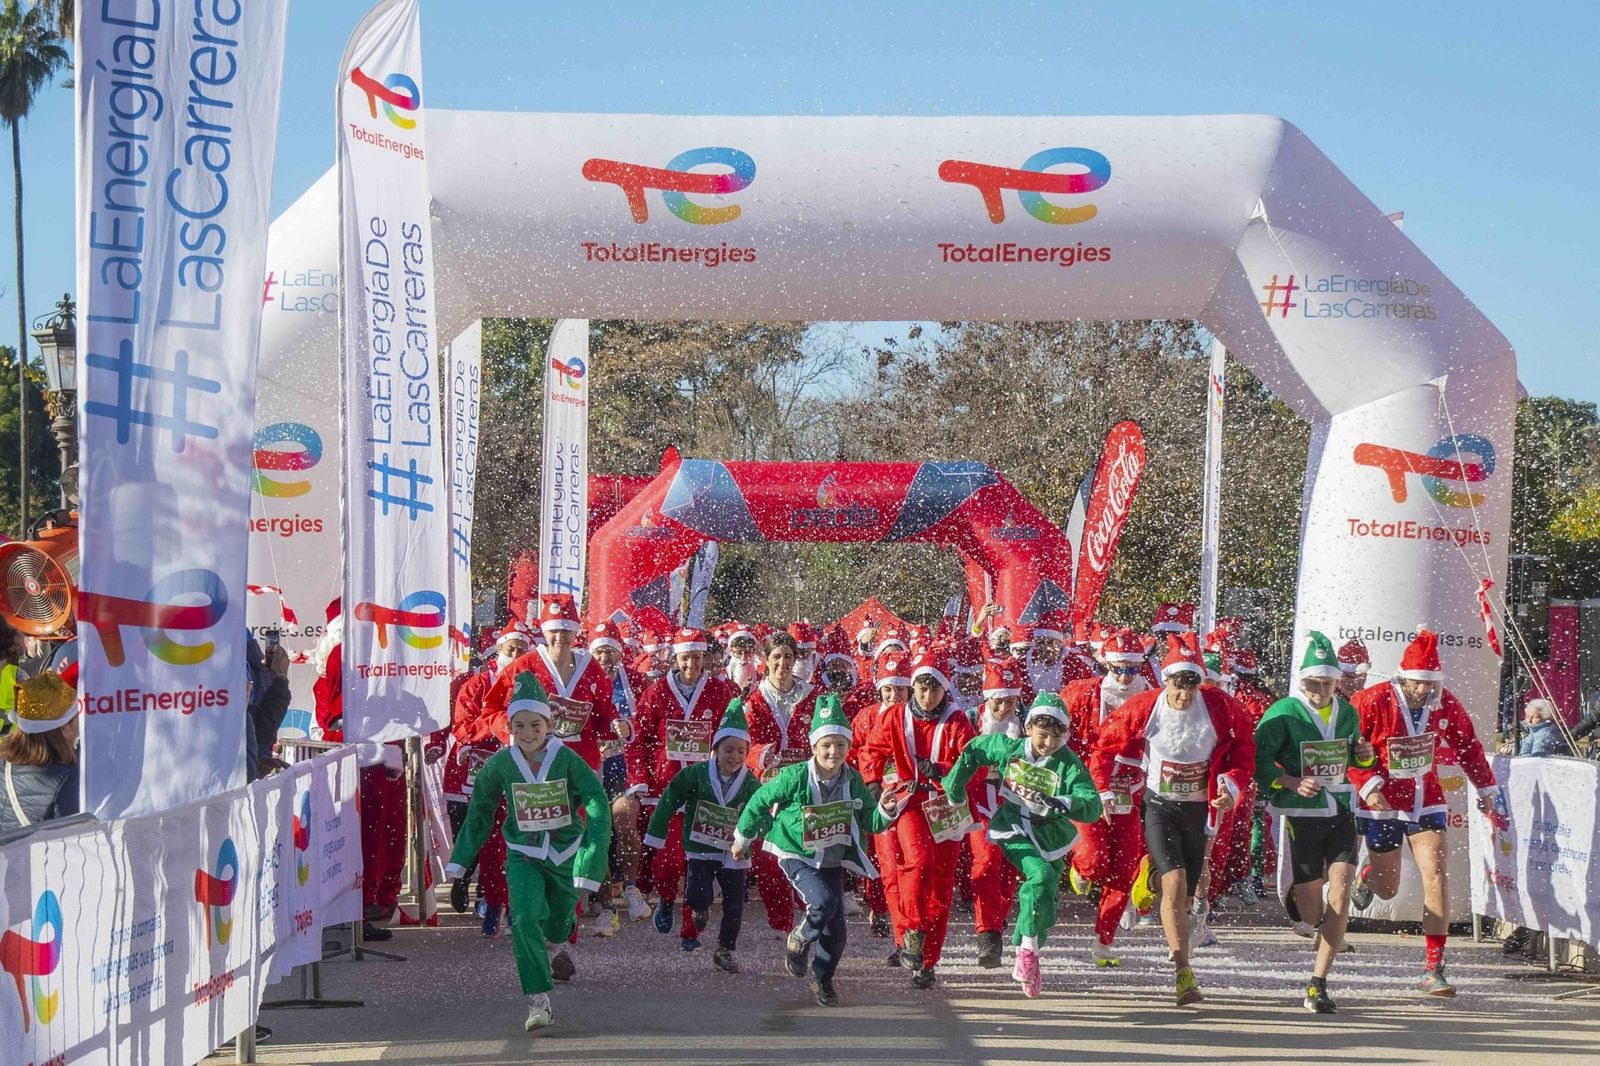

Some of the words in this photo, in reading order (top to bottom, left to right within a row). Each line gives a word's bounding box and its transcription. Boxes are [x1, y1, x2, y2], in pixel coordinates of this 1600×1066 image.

[349, 123, 426, 160] TotalEnergies
[581, 241, 756, 267] TotalEnergies
[937, 241, 1112, 267] TotalEnergies
[1305, 274, 1432, 297] LaEnergíaDe
[1304, 298, 1438, 321] LasCarreras
[400, 222, 432, 446] LasCarreras
[566, 442, 581, 571] LasCarreras
[1347, 518, 1491, 548] TotalEnergies
[675, 741, 700, 753] 799
[1311, 763, 1344, 776] 1207
[1400, 755, 1426, 769] 680
[1172, 782, 1199, 793] 686
[524, 805, 562, 820] 1213
[941, 810, 962, 829] 521
[811, 822, 846, 840] 1348
